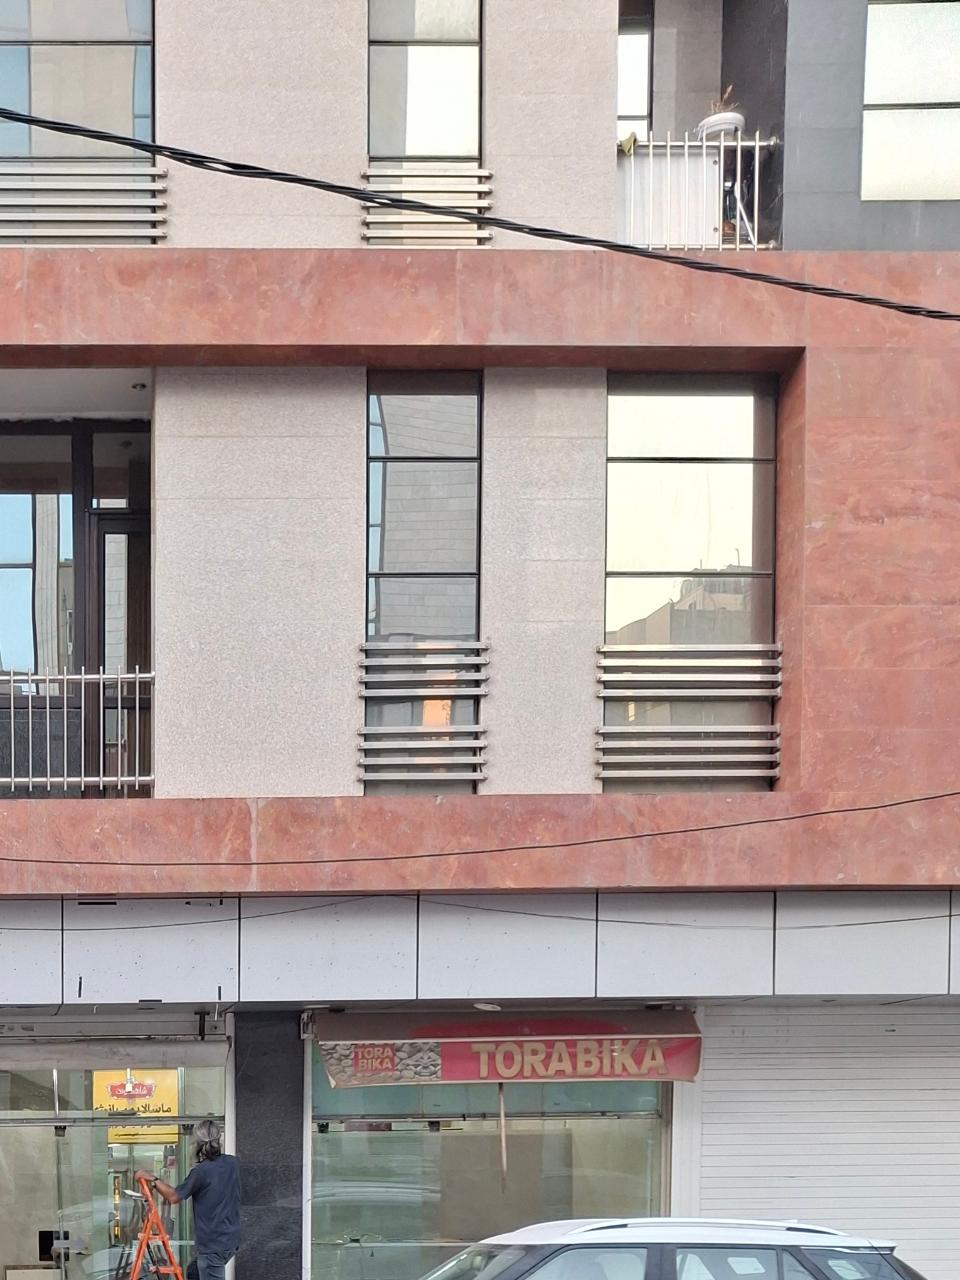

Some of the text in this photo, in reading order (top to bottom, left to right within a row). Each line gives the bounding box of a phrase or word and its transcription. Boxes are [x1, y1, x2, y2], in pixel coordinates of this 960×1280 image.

[356, 1047, 394, 1059] TORA
[471, 1038, 668, 1079] TORABIKA
[358, 1058, 393, 1071] BIKA
